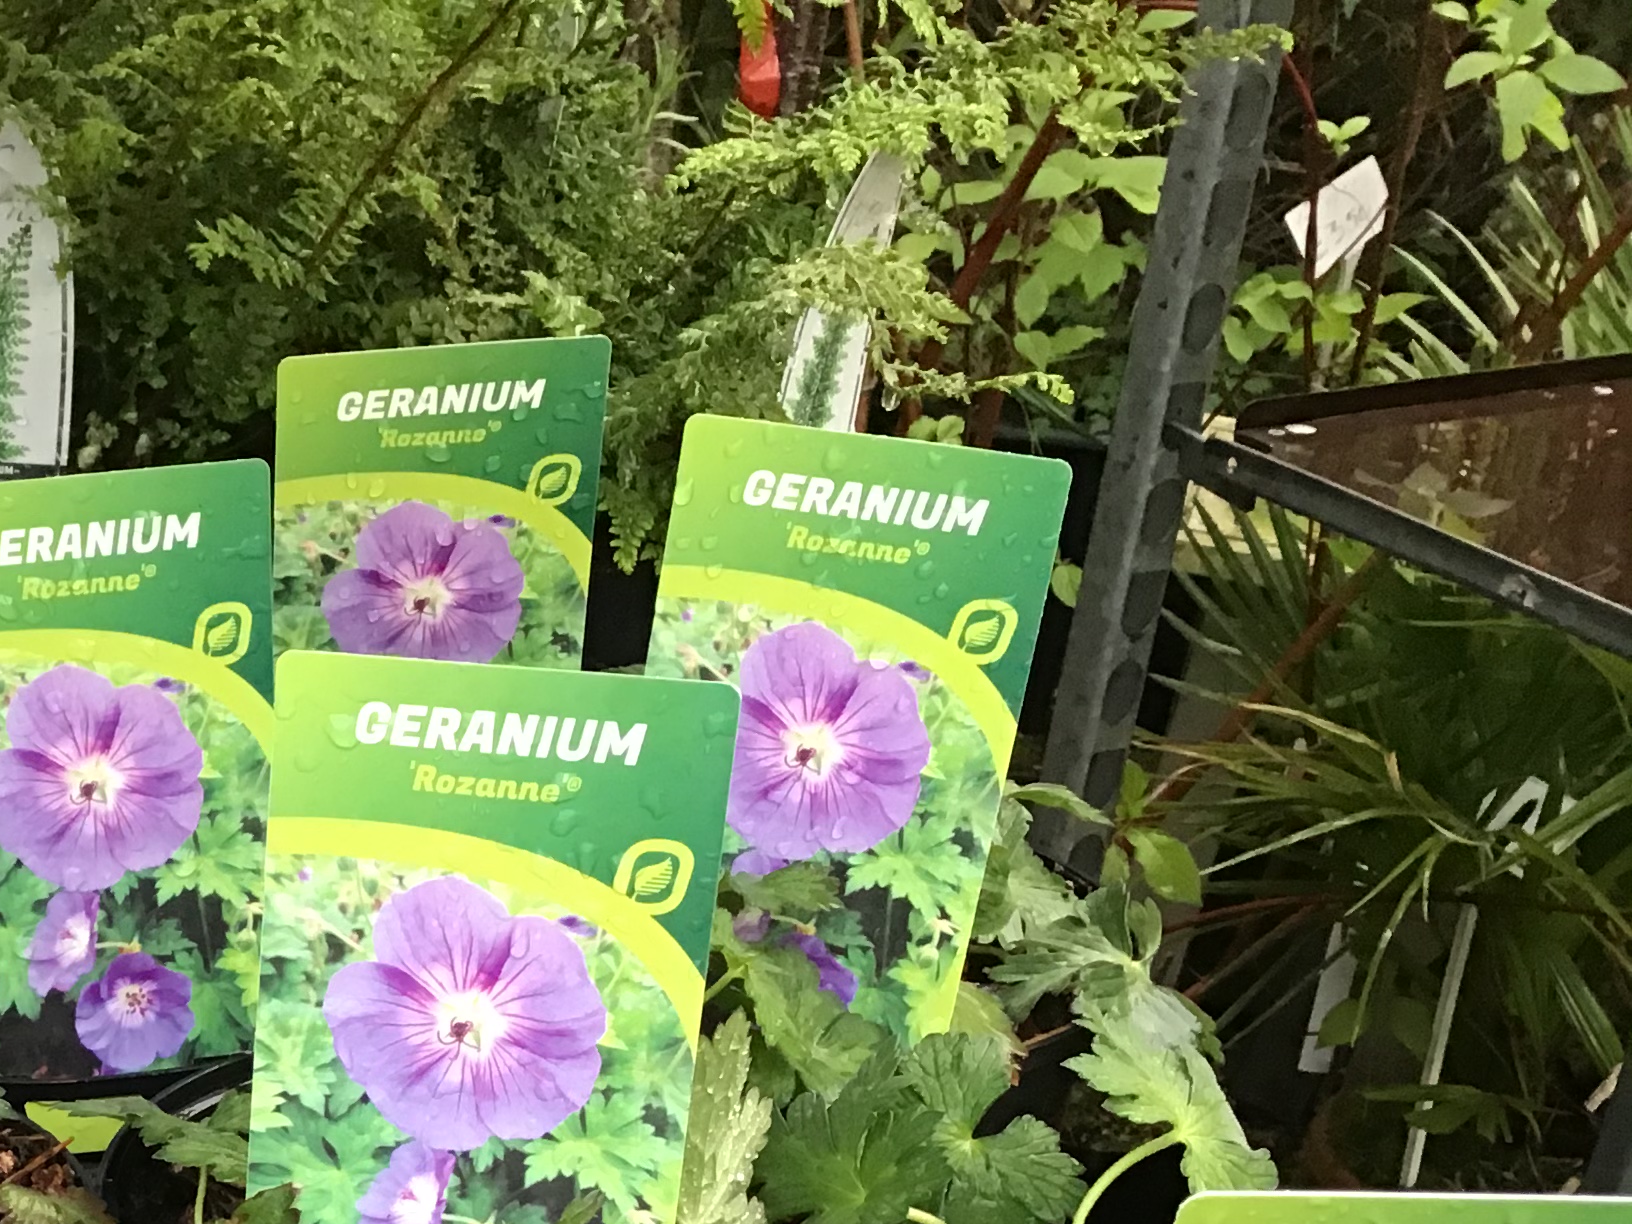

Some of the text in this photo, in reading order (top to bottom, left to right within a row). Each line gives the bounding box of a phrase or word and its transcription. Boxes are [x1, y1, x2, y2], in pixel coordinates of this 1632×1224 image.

[337, 379, 546, 422] GERANIUM
[743, 470, 990, 536] GERANIUM
[355, 701, 648, 766] GERANIUM
